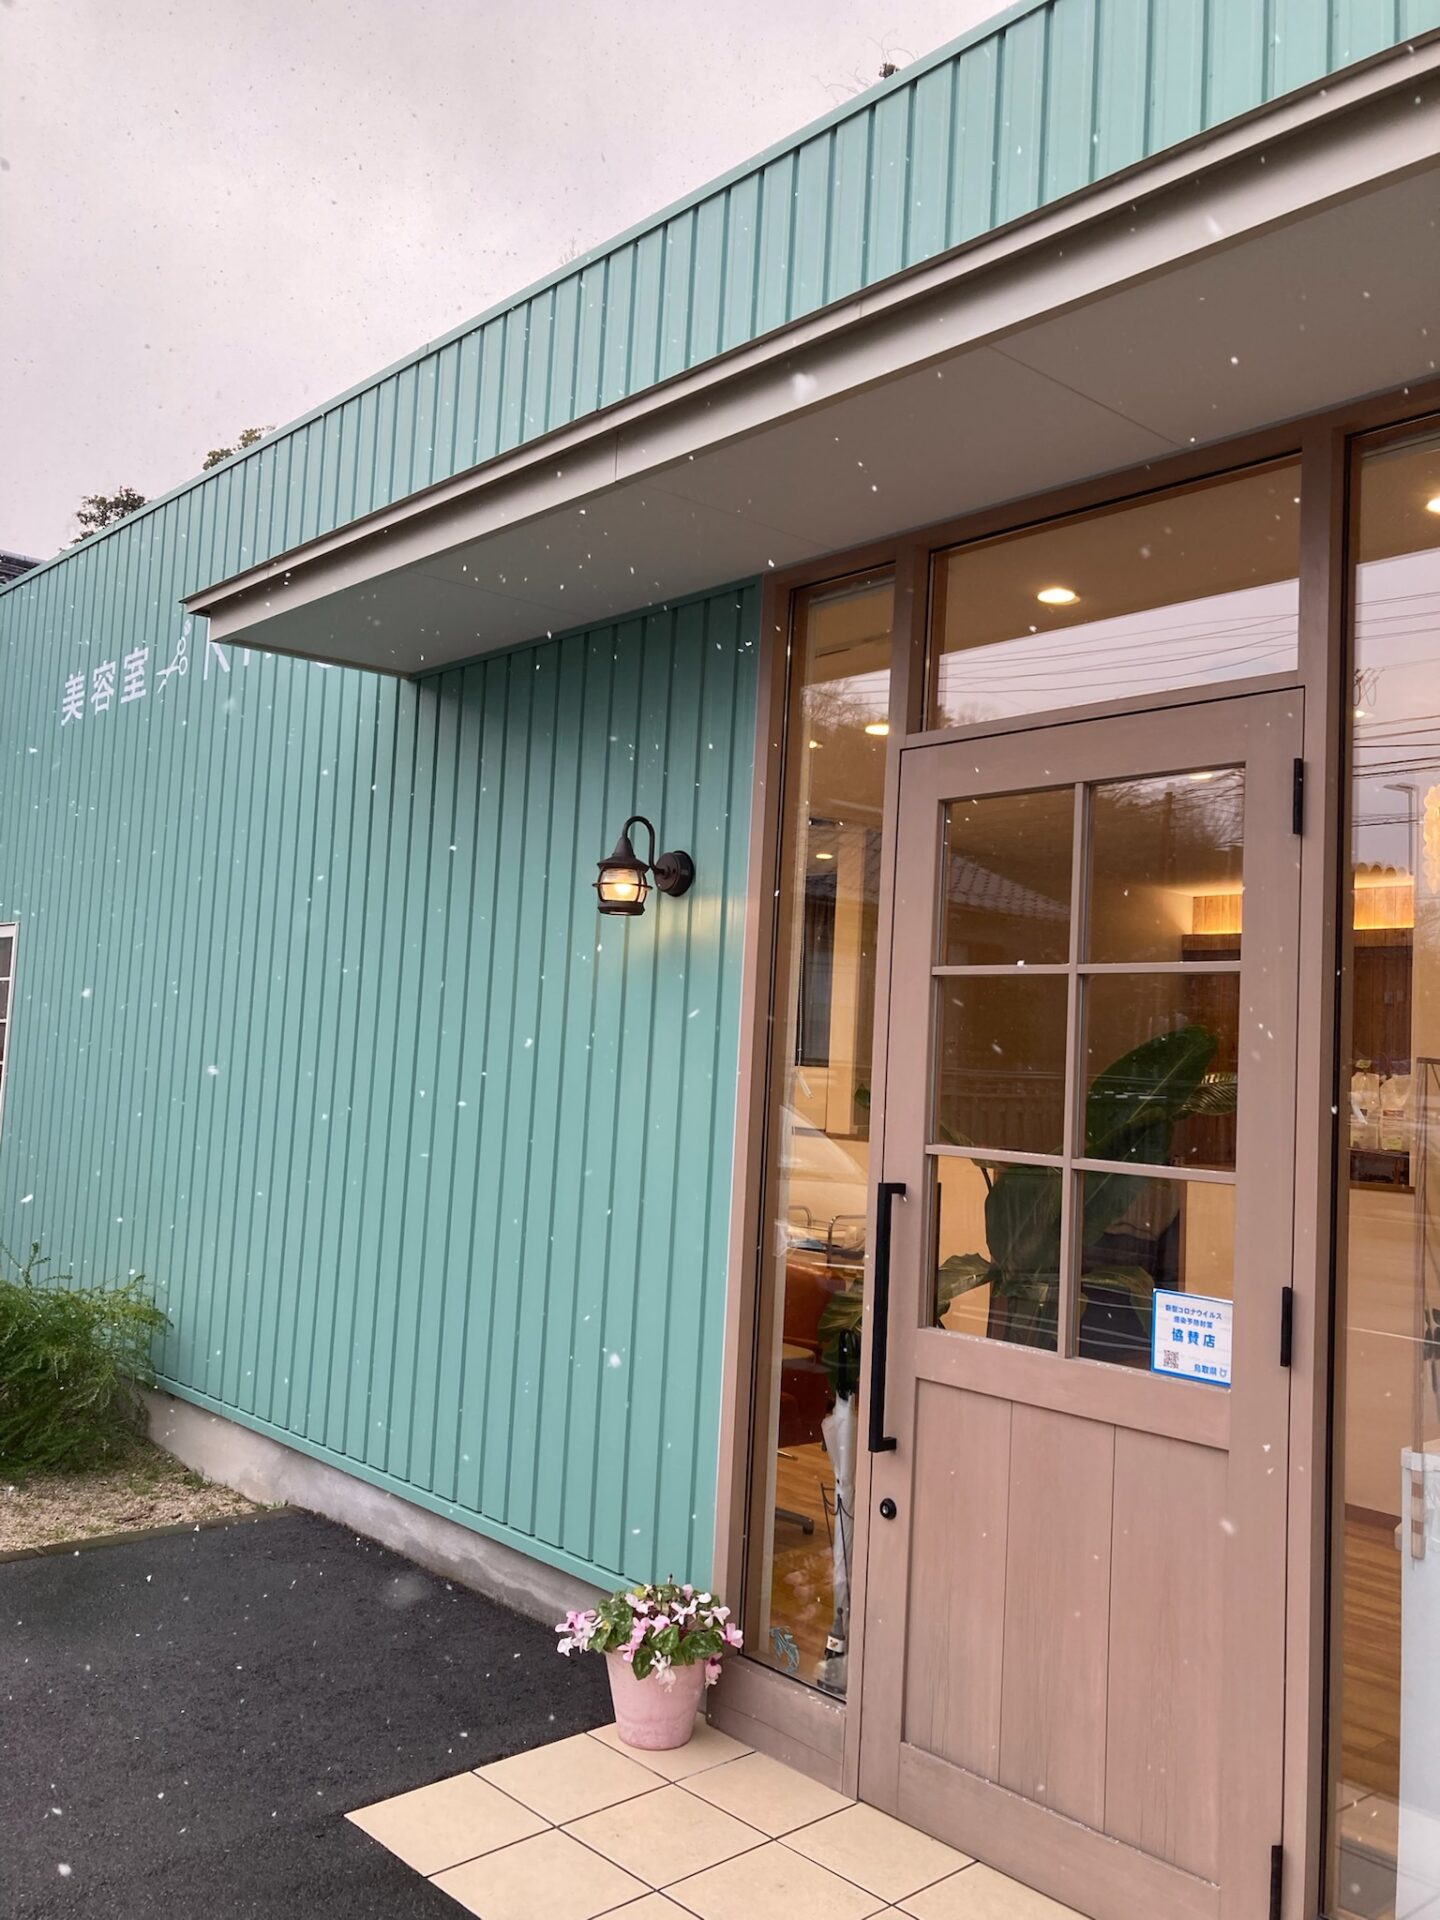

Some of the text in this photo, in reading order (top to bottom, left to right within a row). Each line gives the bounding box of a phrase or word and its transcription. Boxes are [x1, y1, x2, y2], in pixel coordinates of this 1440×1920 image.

[61, 647, 149, 726] 美容室
[1165, 1304, 1223, 1320] 新型コロナウイルス
[1172, 1327, 1216, 1348] 協賛店
